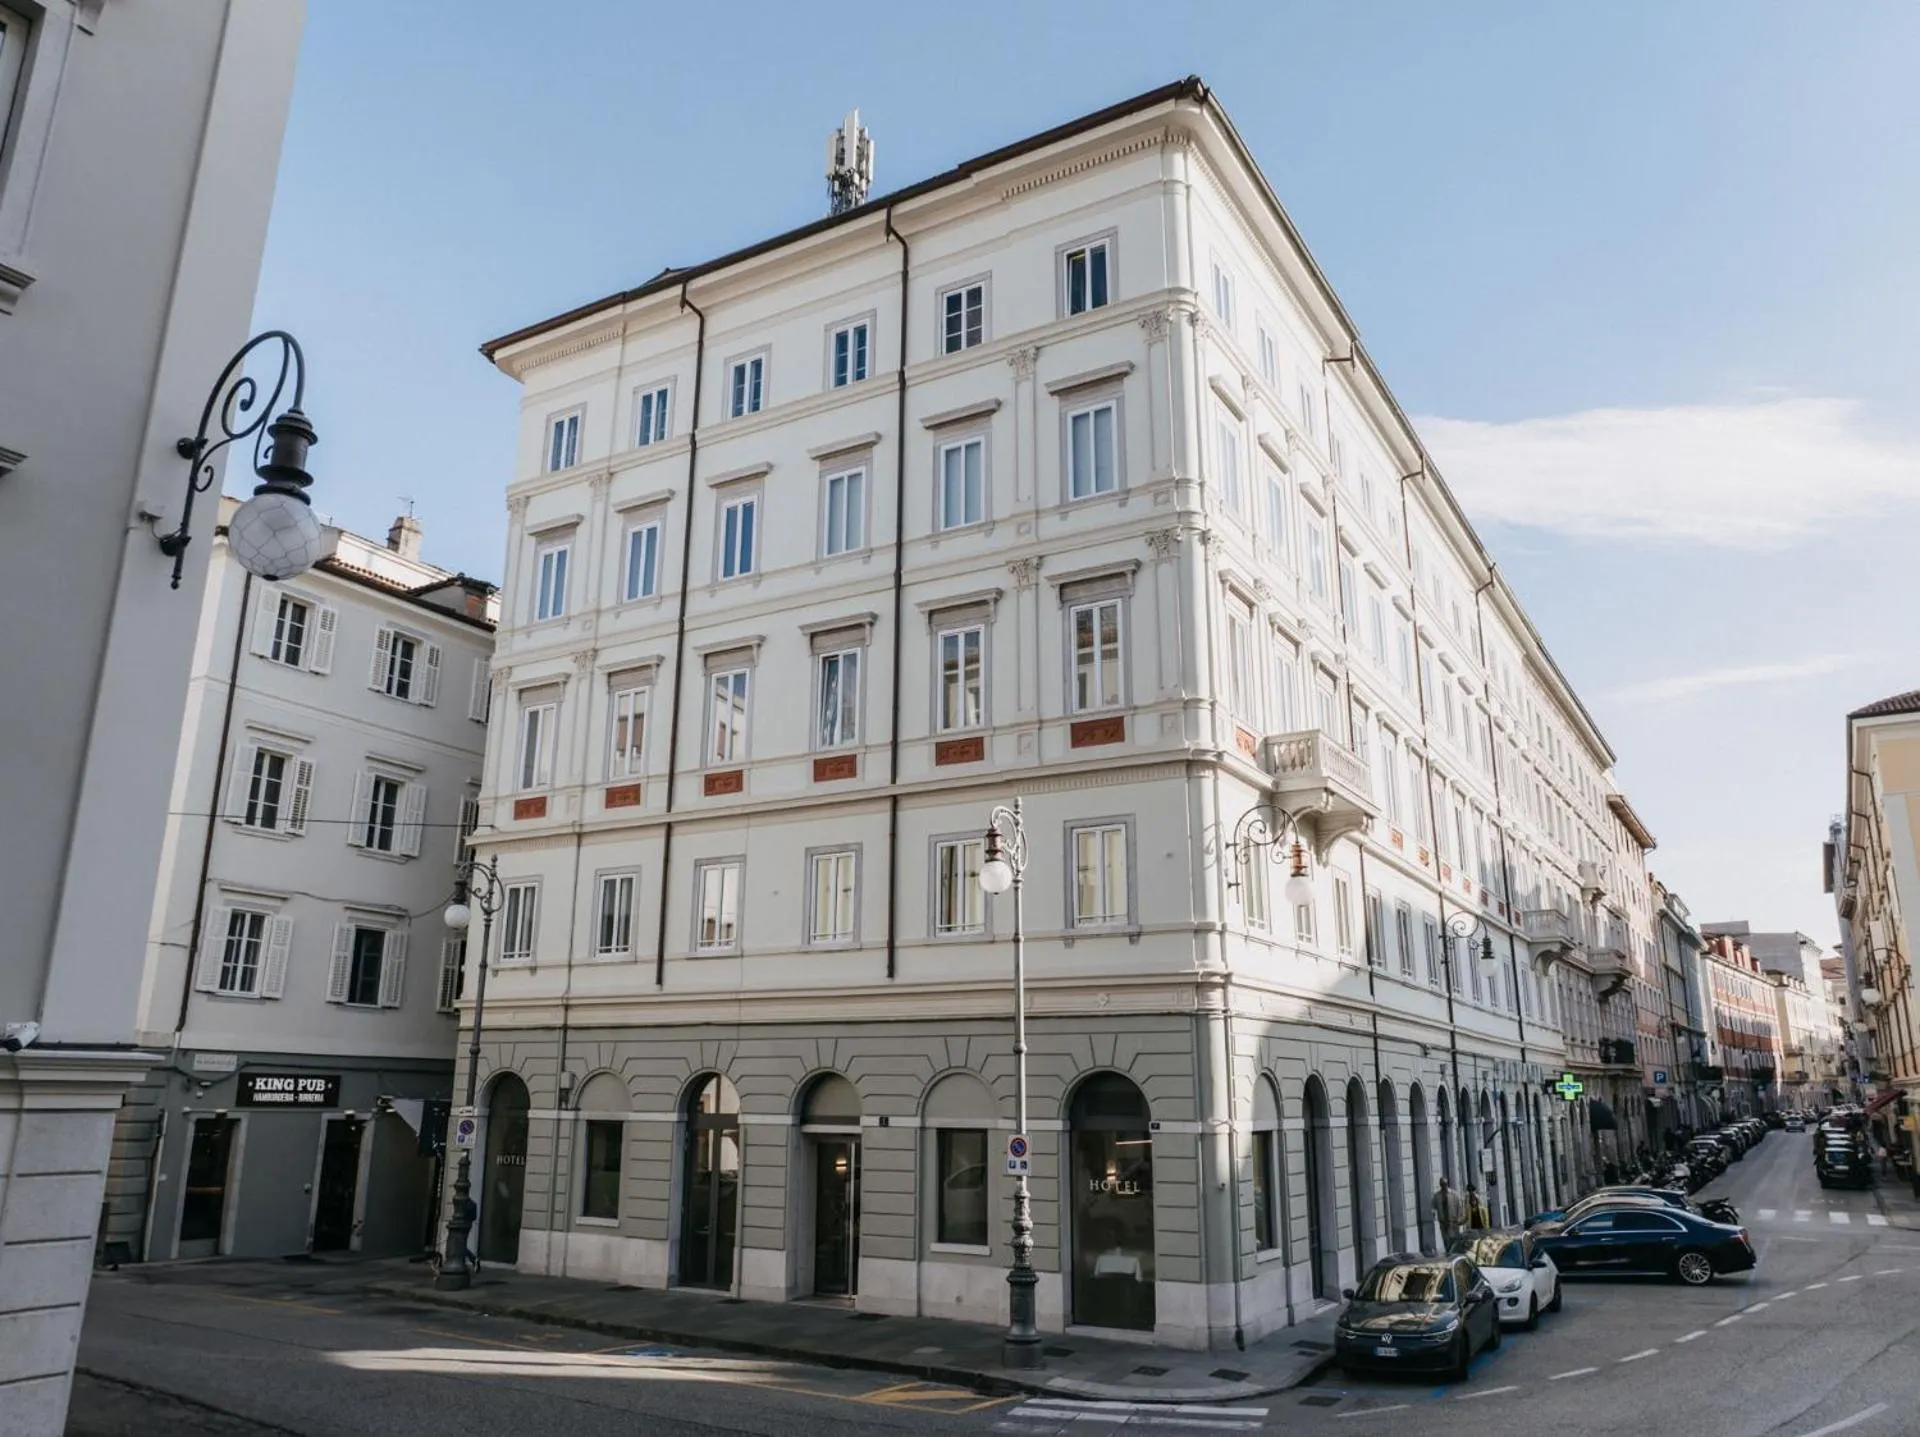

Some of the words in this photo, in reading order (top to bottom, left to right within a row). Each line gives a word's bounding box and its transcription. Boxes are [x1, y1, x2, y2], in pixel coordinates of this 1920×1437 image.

[1656, 1073, 1664, 1082] P
[254, 1077, 294, 1091] KING
[296, 1078, 326, 1092] PUB
[495, 1154, 526, 1166] HOTEL
[1089, 1179, 1141, 1193] HOTEL
